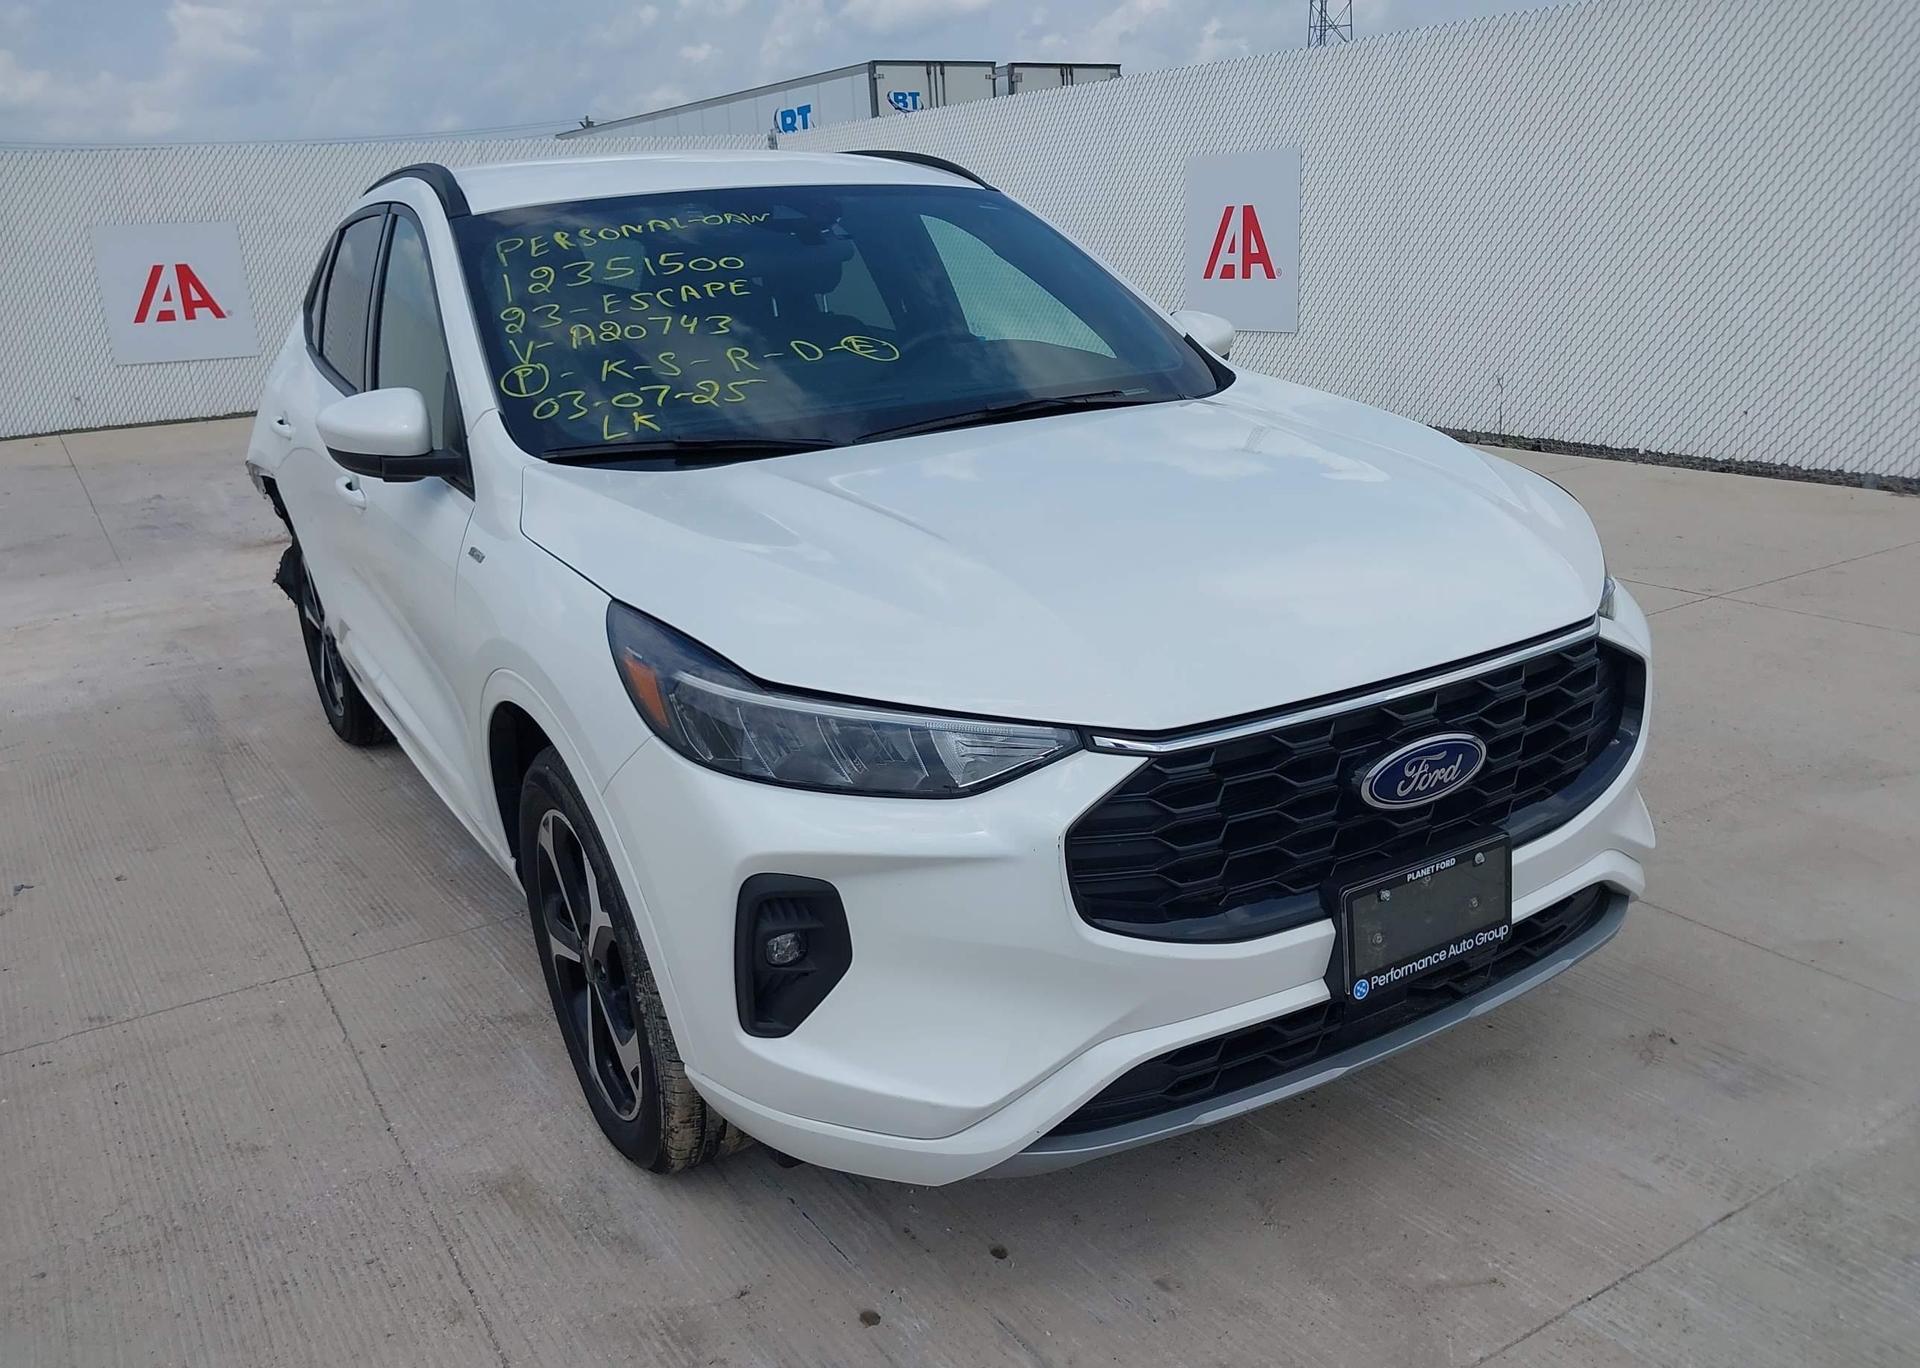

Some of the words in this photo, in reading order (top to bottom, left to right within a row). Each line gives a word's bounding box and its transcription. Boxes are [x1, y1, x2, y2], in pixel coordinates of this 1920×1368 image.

[1397, 750, 1463, 797] Ford
[1406, 864, 1435, 882] PLANET
[1435, 857, 1456, 873] FORD
[1371, 949, 1446, 990] Performance
[1448, 938, 1474, 959] Auto
[1475, 924, 1509, 946] Group
